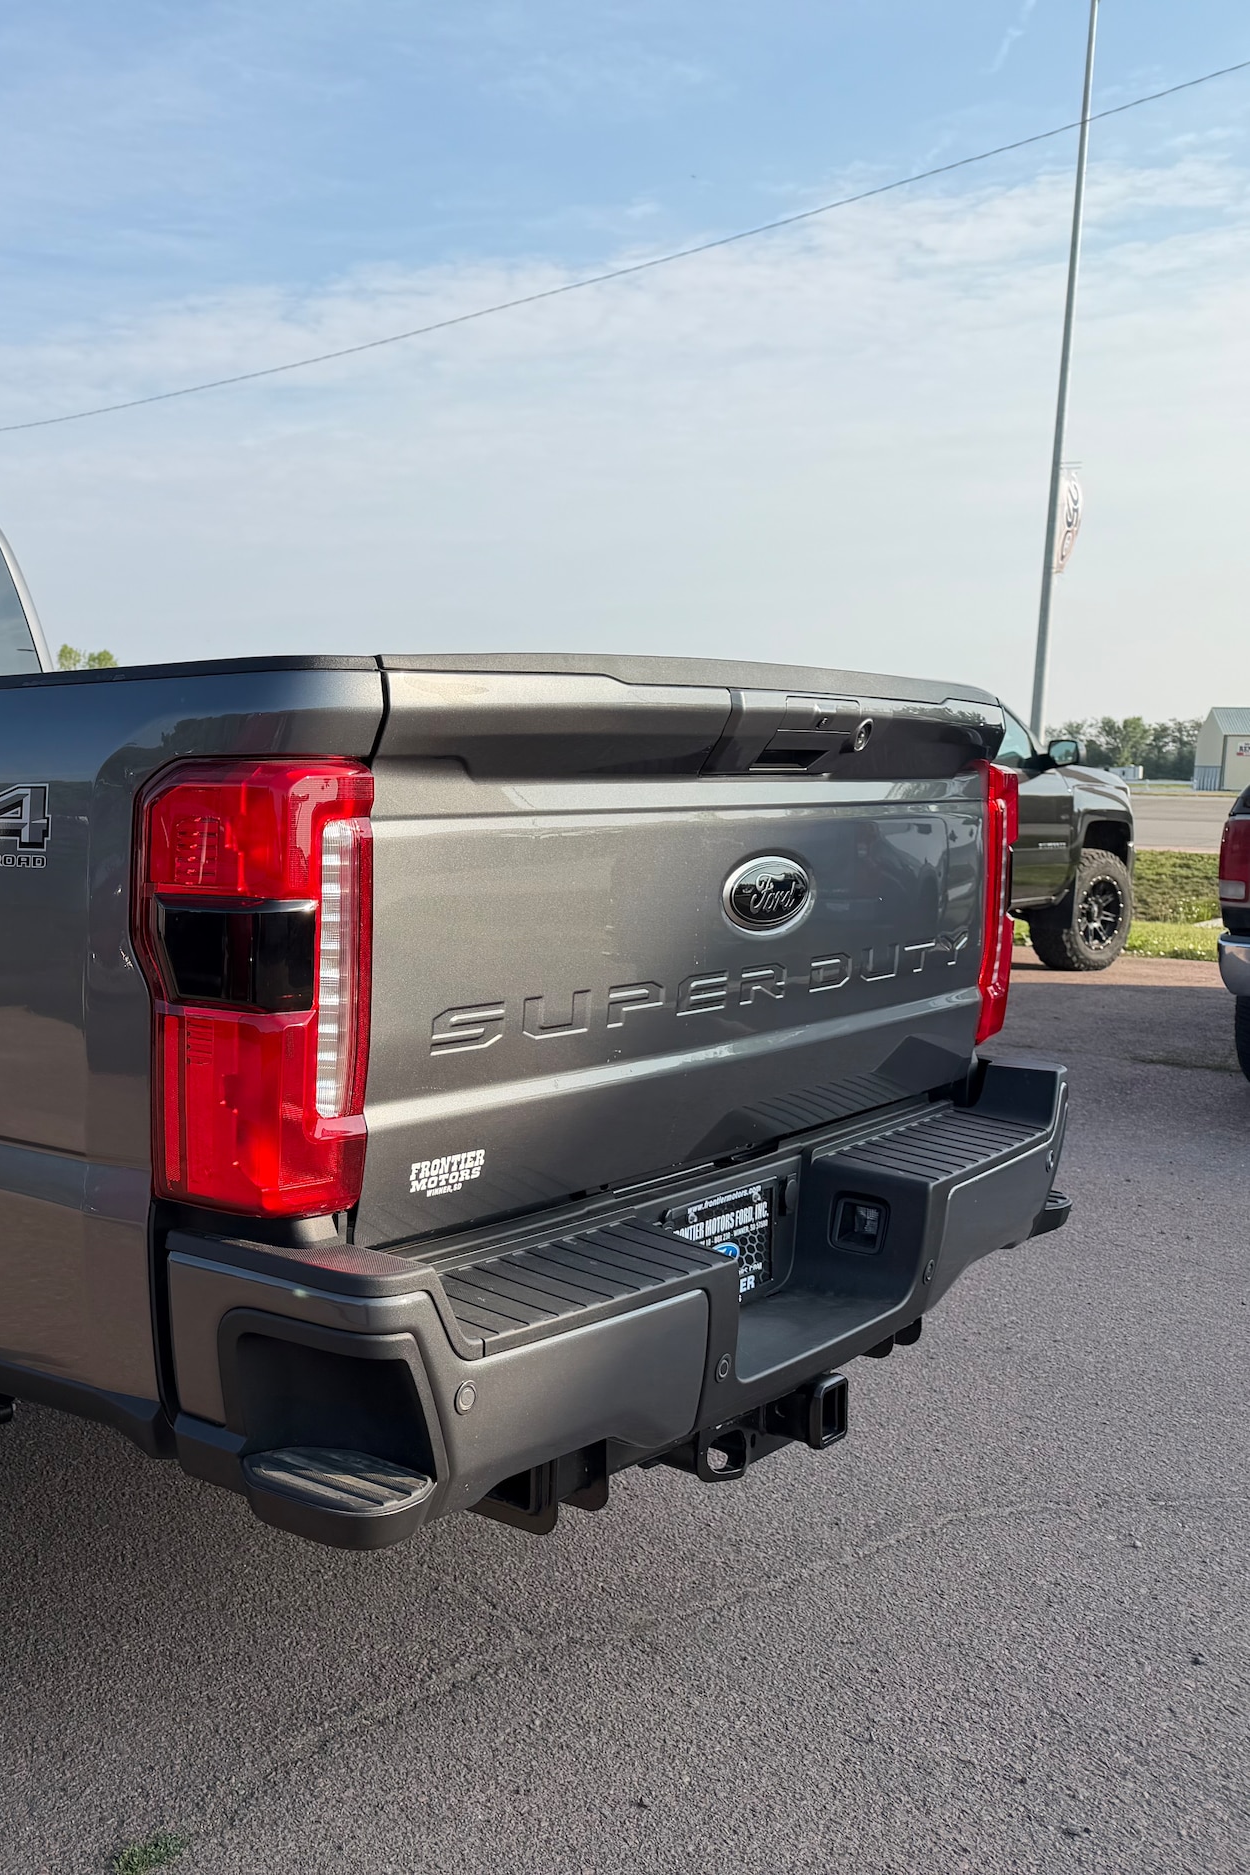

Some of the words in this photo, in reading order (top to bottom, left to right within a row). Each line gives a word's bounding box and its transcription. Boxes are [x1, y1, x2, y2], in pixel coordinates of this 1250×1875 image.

[750, 872, 796, 914] Ford
[429, 960, 787, 1057] SUPER
[809, 928, 969, 993] DUTY
[410, 1149, 485, 1181] FRONTIER
[410, 1166, 481, 1193] MOTORS
[426, 1185, 452, 1197] WINNER,
[453, 1182, 463, 1191] SD
[688, 1185, 762, 1215] www.frontiermotors.com
[673, 1221, 705, 1241] ONTIER
[705, 1211, 735, 1237] MOTORS
[755, 1201, 769, 1220] INC.
